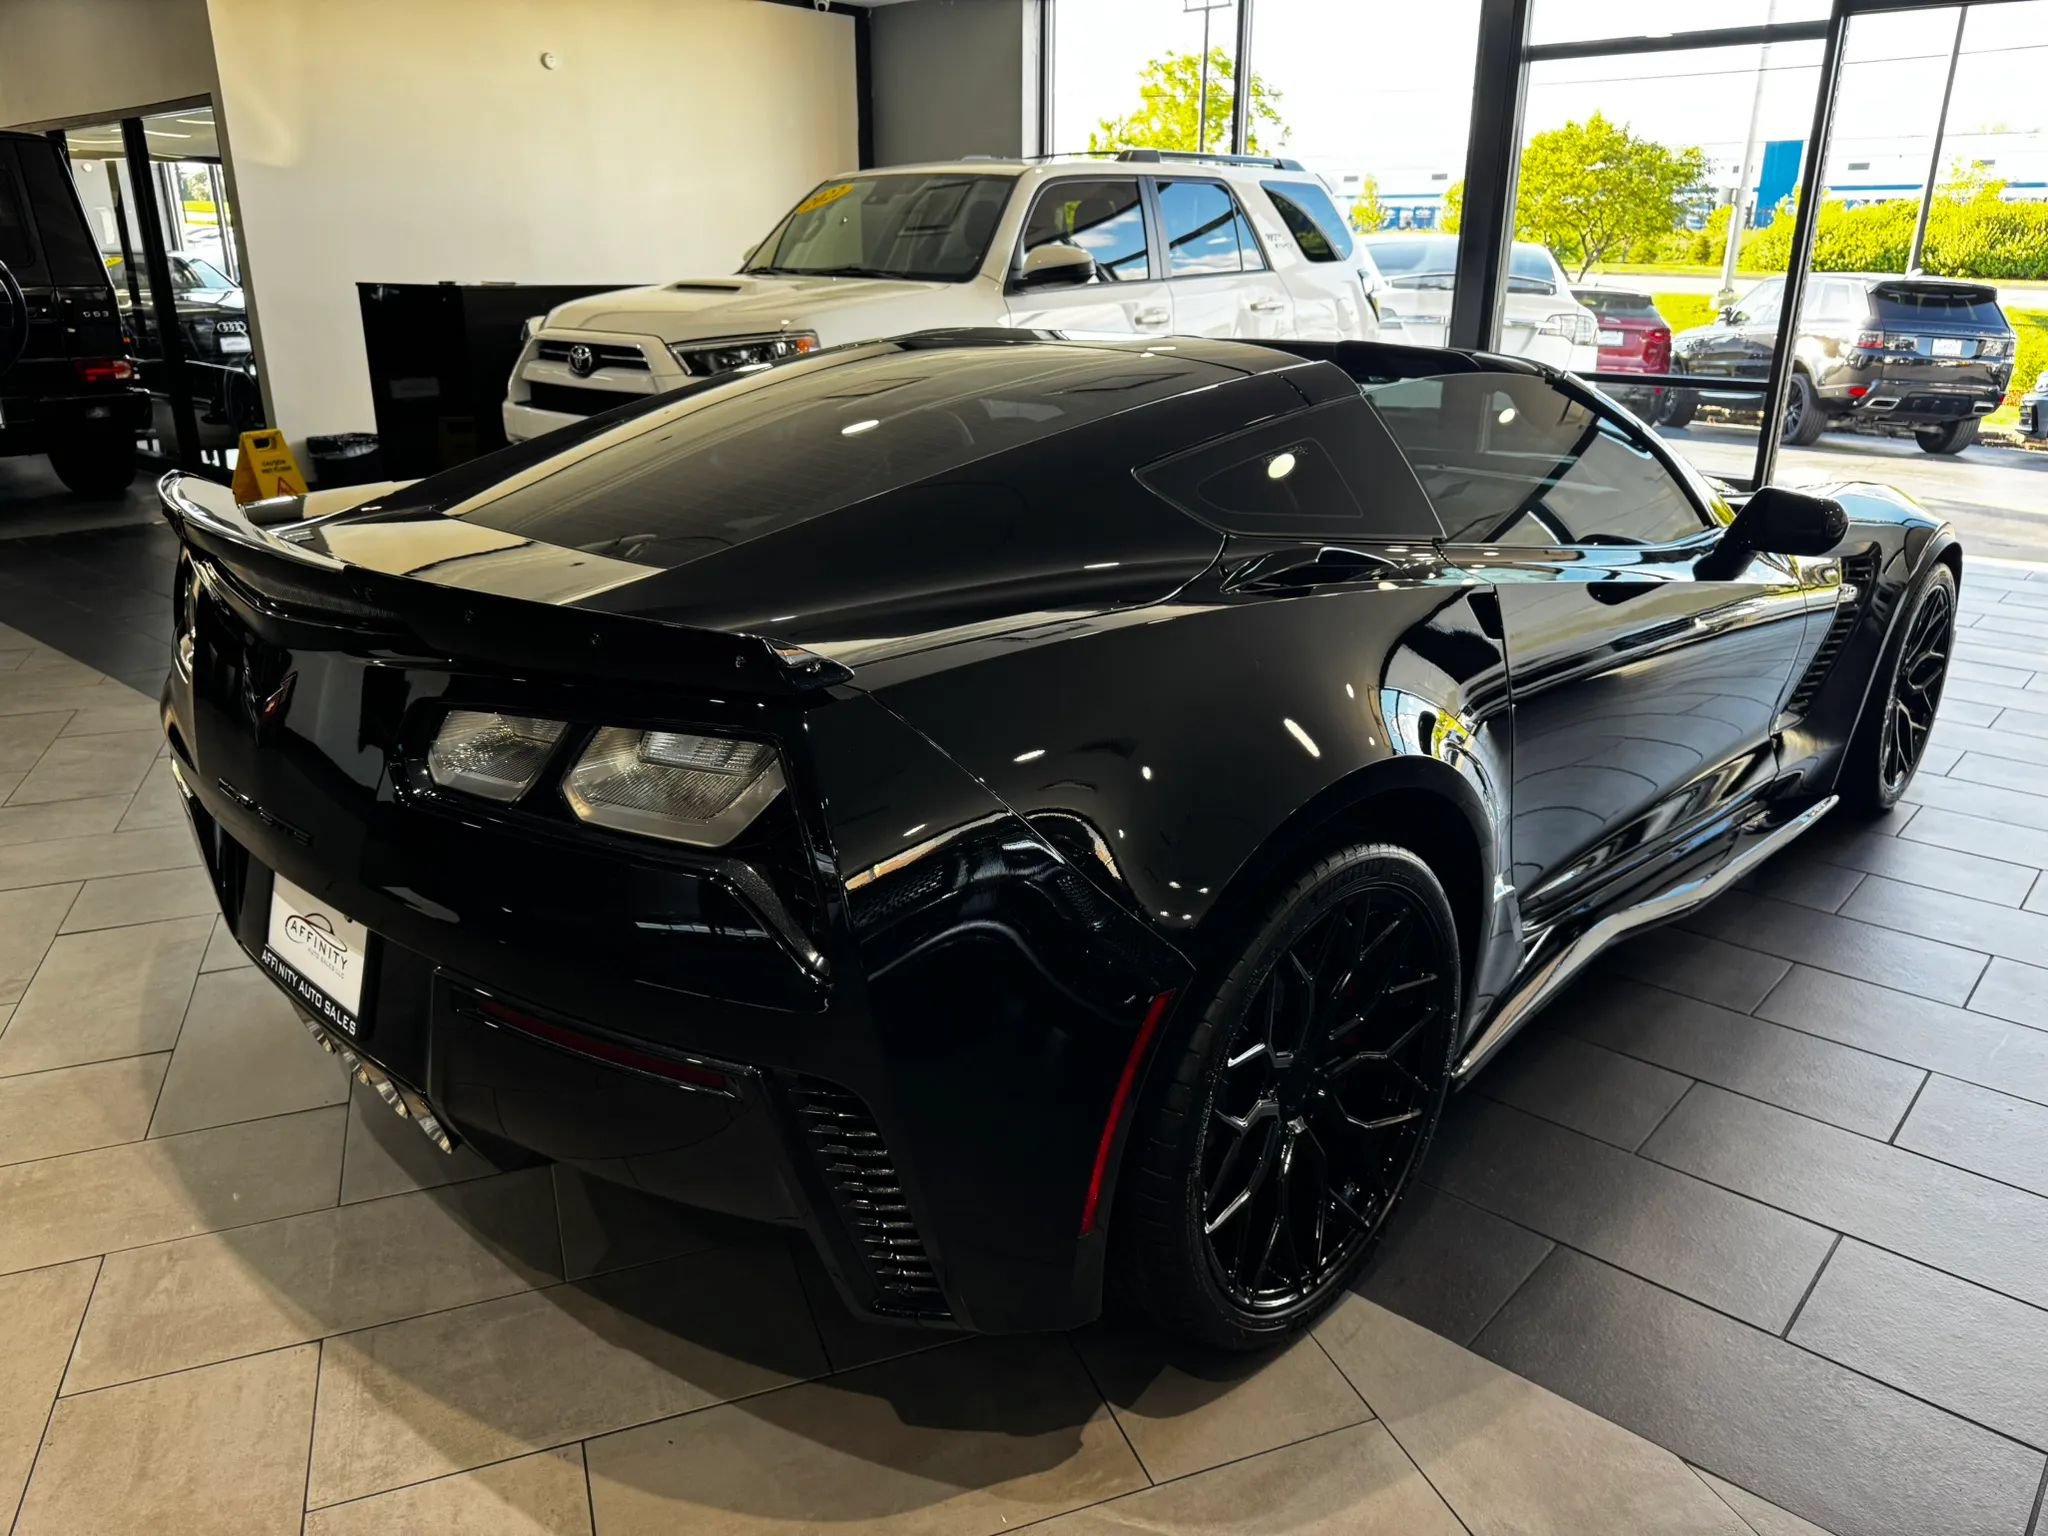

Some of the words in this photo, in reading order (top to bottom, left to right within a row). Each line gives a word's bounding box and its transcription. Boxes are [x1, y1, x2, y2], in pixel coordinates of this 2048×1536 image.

[290, 919, 348, 971] AFFINITY
[320, 956, 334, 971] SALES
[261, 949, 298, 987] AFFINITY
[298, 983, 322, 1008] AUTO
[323, 1001, 356, 1036] SALES
